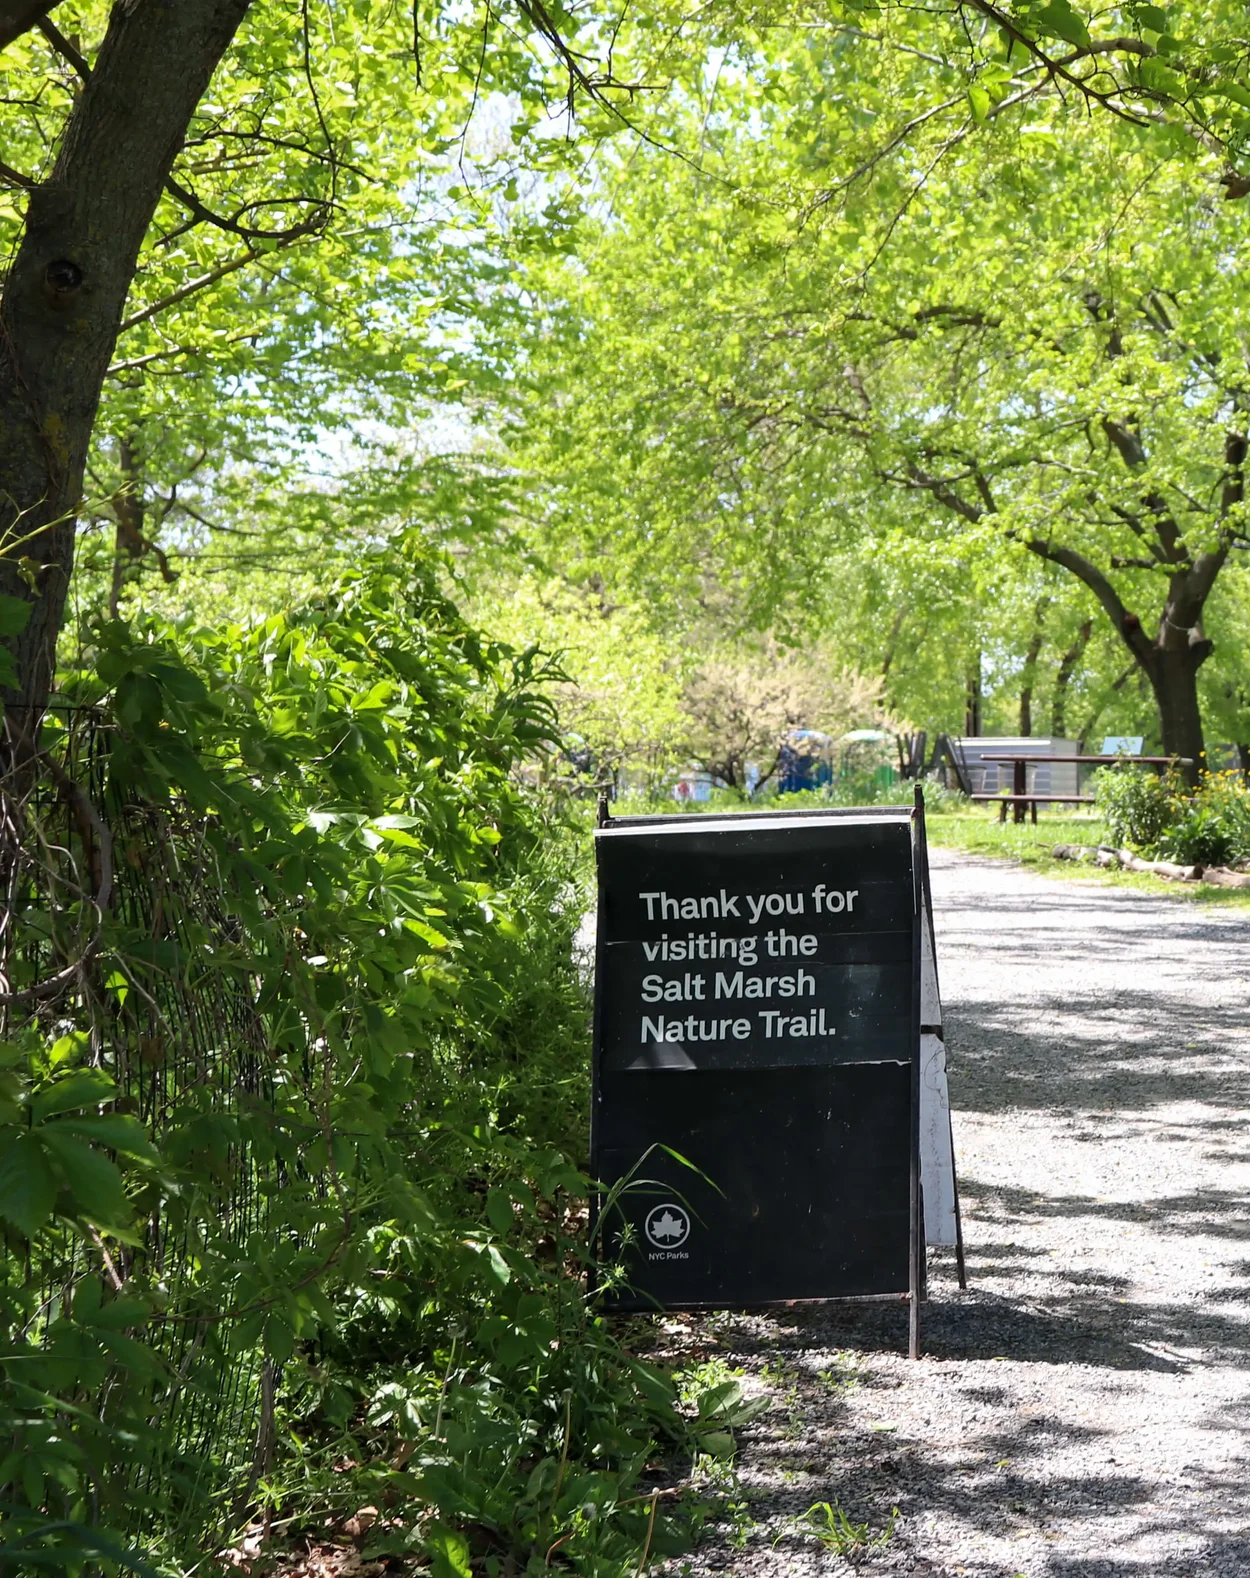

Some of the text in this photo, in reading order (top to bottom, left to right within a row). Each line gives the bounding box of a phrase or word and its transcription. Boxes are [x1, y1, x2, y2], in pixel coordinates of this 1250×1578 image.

[639, 884, 858, 924] Thank you for
[642, 928, 818, 966] visiting the
[641, 969, 816, 1003] Salt Marsh
[641, 1009, 836, 1043] Nature Trail.
[648, 1252, 689, 1260] NYC Parks
